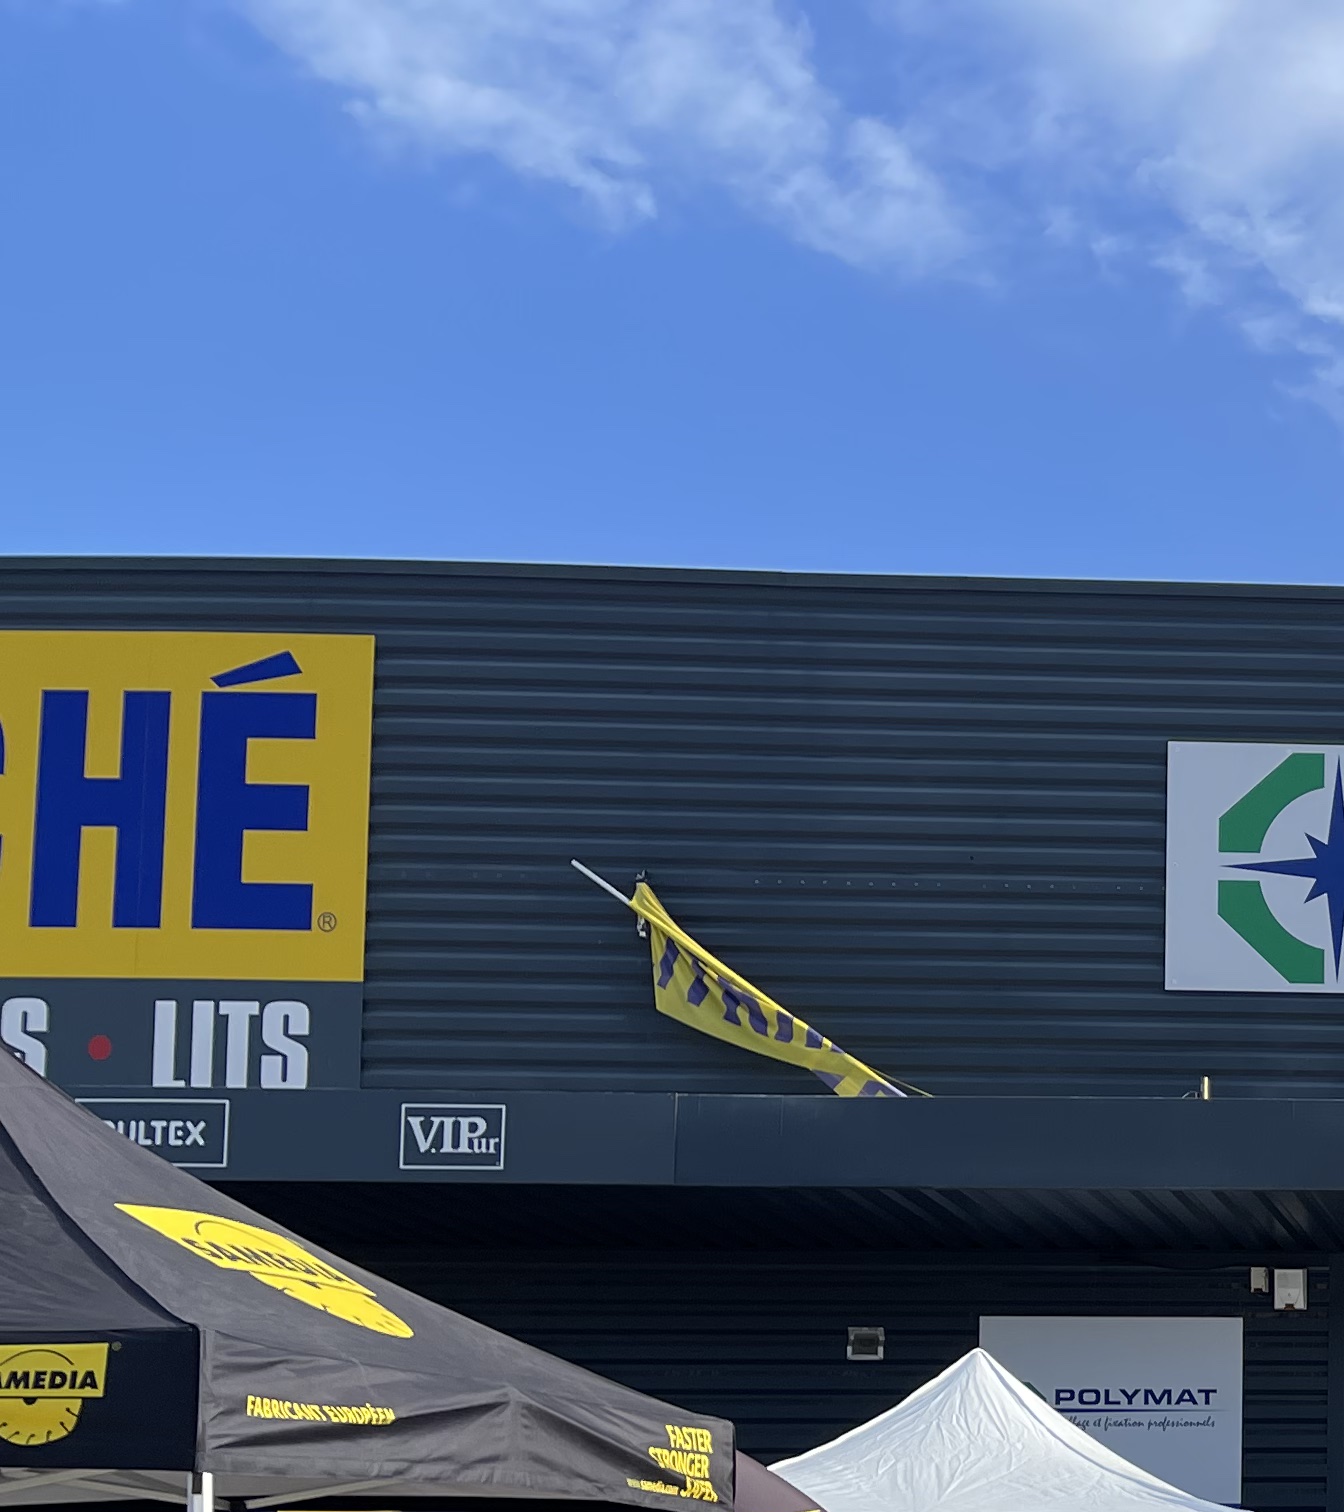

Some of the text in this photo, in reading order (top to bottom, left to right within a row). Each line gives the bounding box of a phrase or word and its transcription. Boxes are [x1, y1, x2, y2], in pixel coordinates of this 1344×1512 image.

[0, 650, 317, 930] HÉ
[152, 1000, 311, 1090] LITS
[101, 1120, 207, 1147] ULTEX
[246, 1394, 327, 1423] FABRICANT
[1054, 1388, 1218, 1406] POLYMAT
[1147, 1415, 1216, 1432] professionnels
[665, 1424, 713, 1453] FASTER
[648, 1446, 710, 1479] STRONGER
